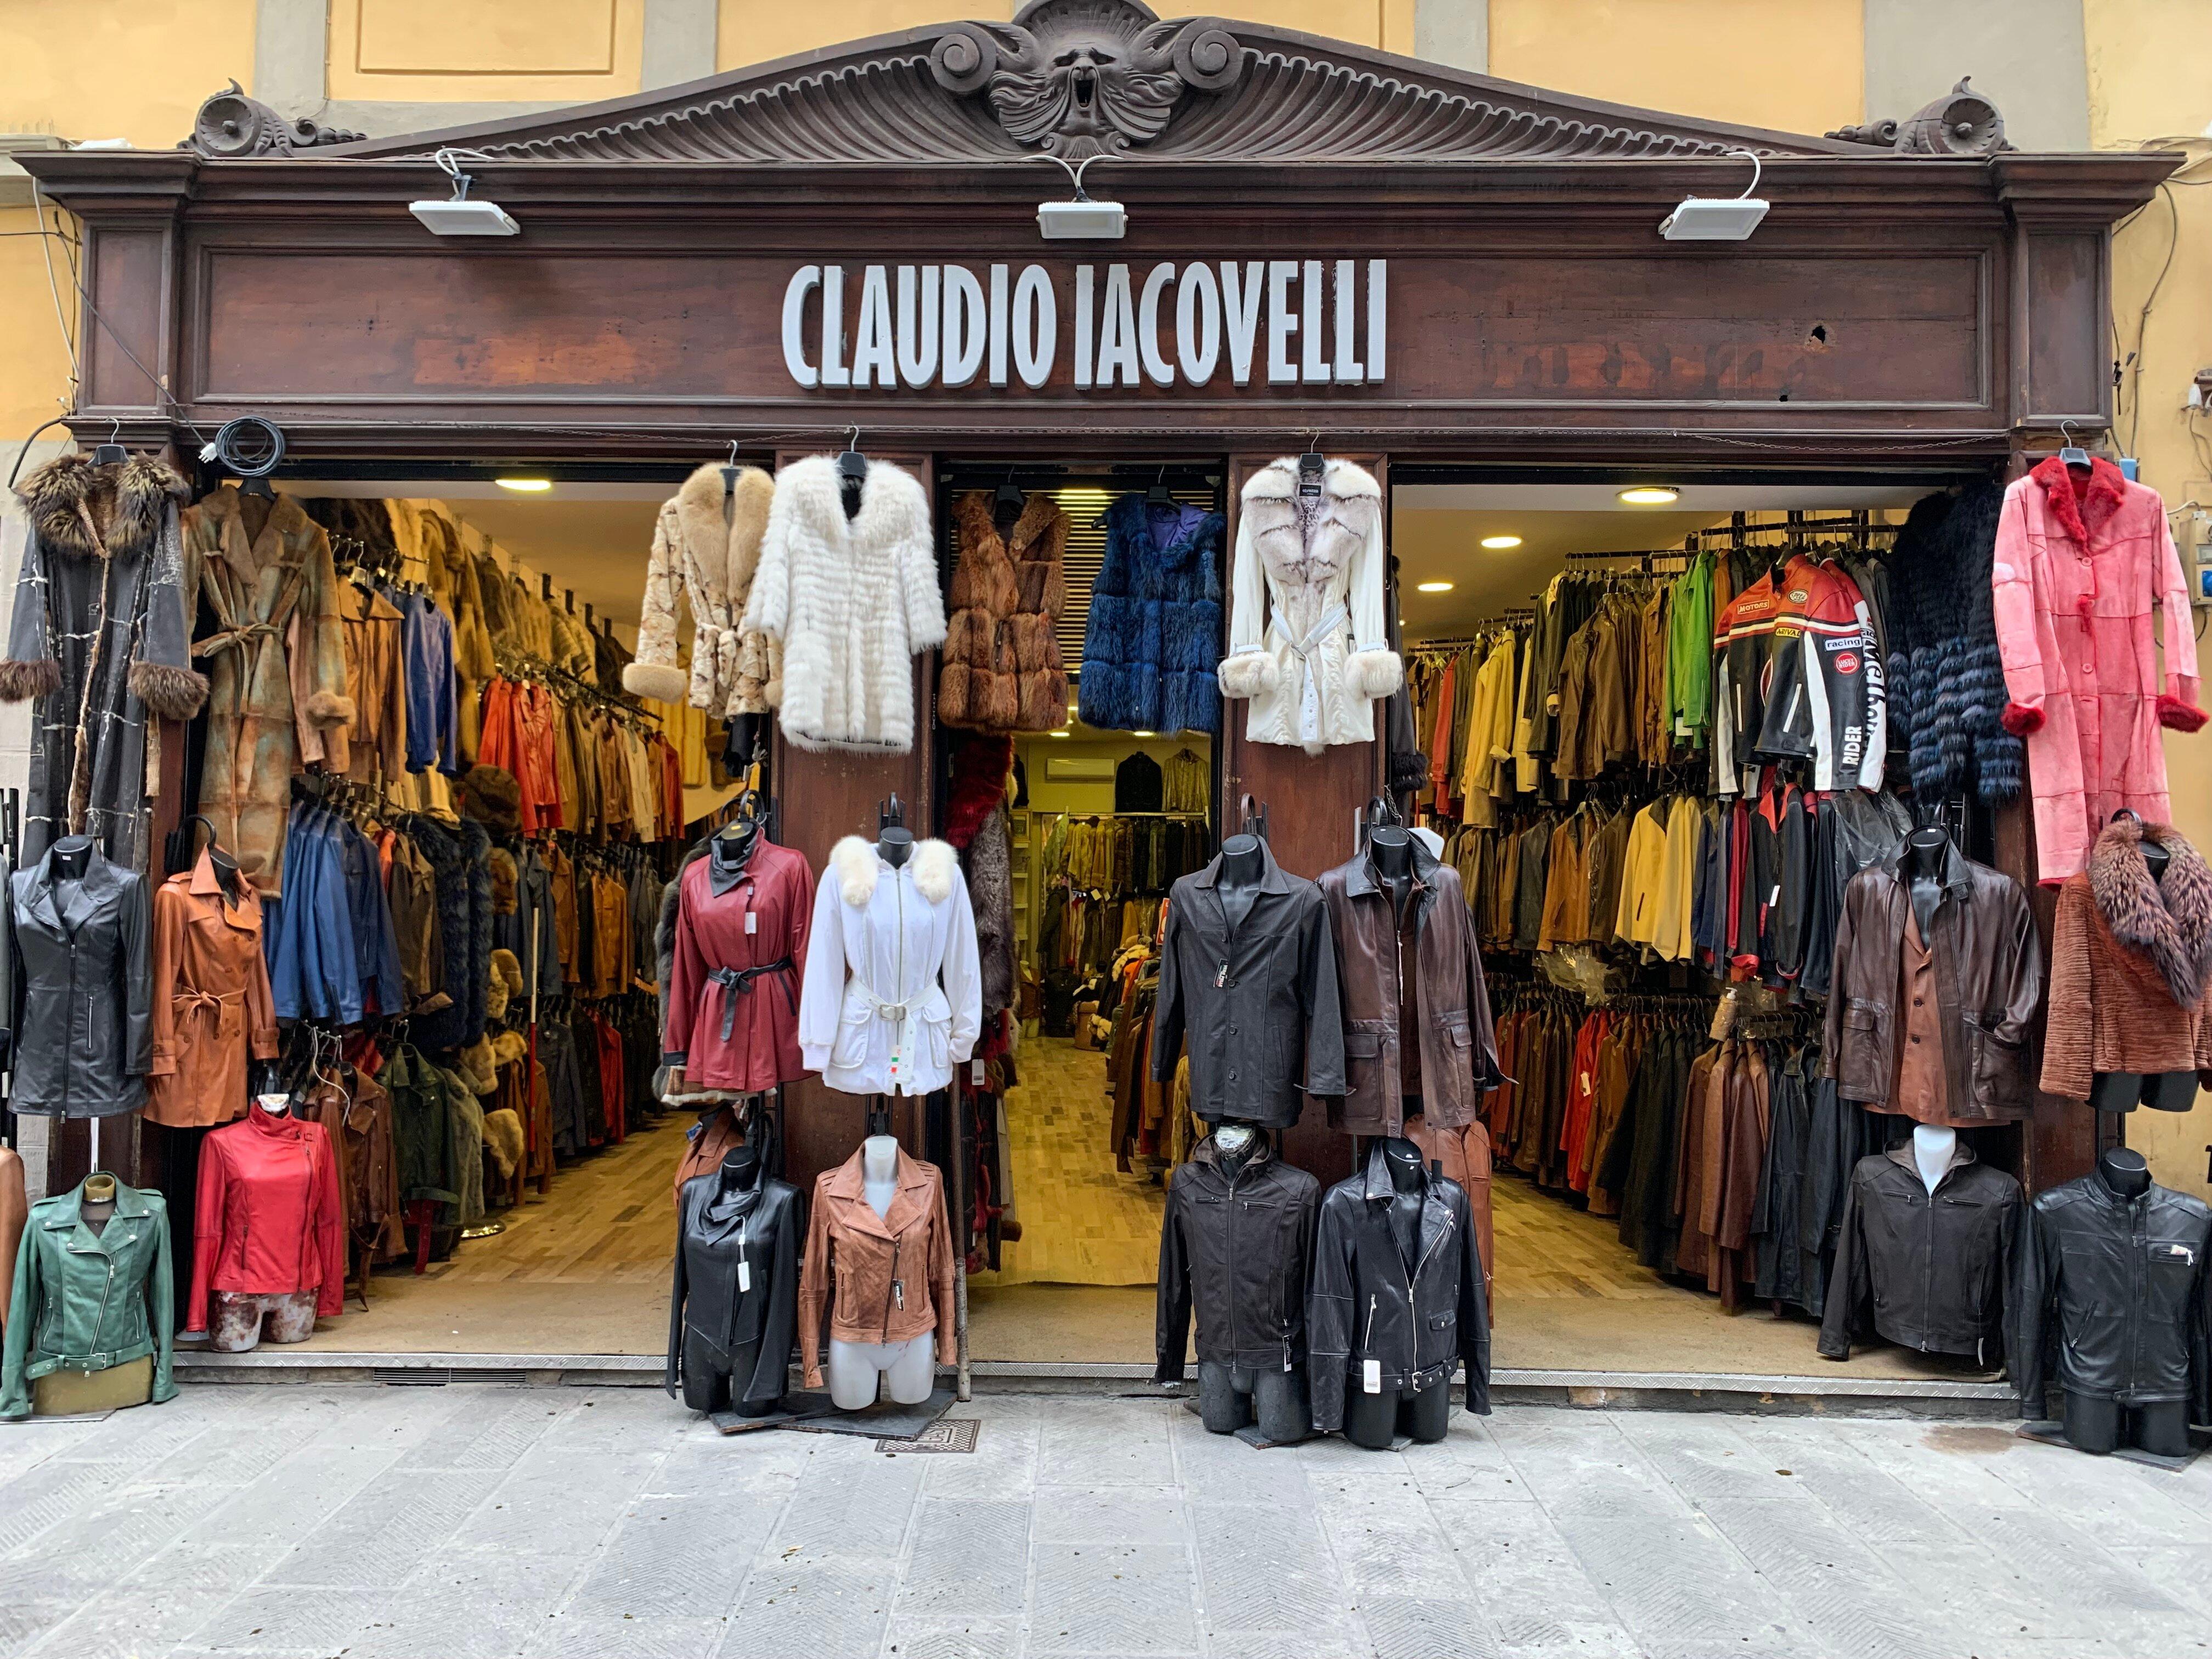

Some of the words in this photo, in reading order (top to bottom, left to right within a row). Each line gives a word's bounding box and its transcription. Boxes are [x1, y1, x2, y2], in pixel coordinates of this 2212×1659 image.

[782, 263, 1057, 390] CLAUDIO
[1074, 259, 1386, 390] IACOVELLI
[1739, 601, 1768, 613] MOTORS
[1827, 639, 1860, 647] racing
[1842, 726, 1862, 765] RIDER
